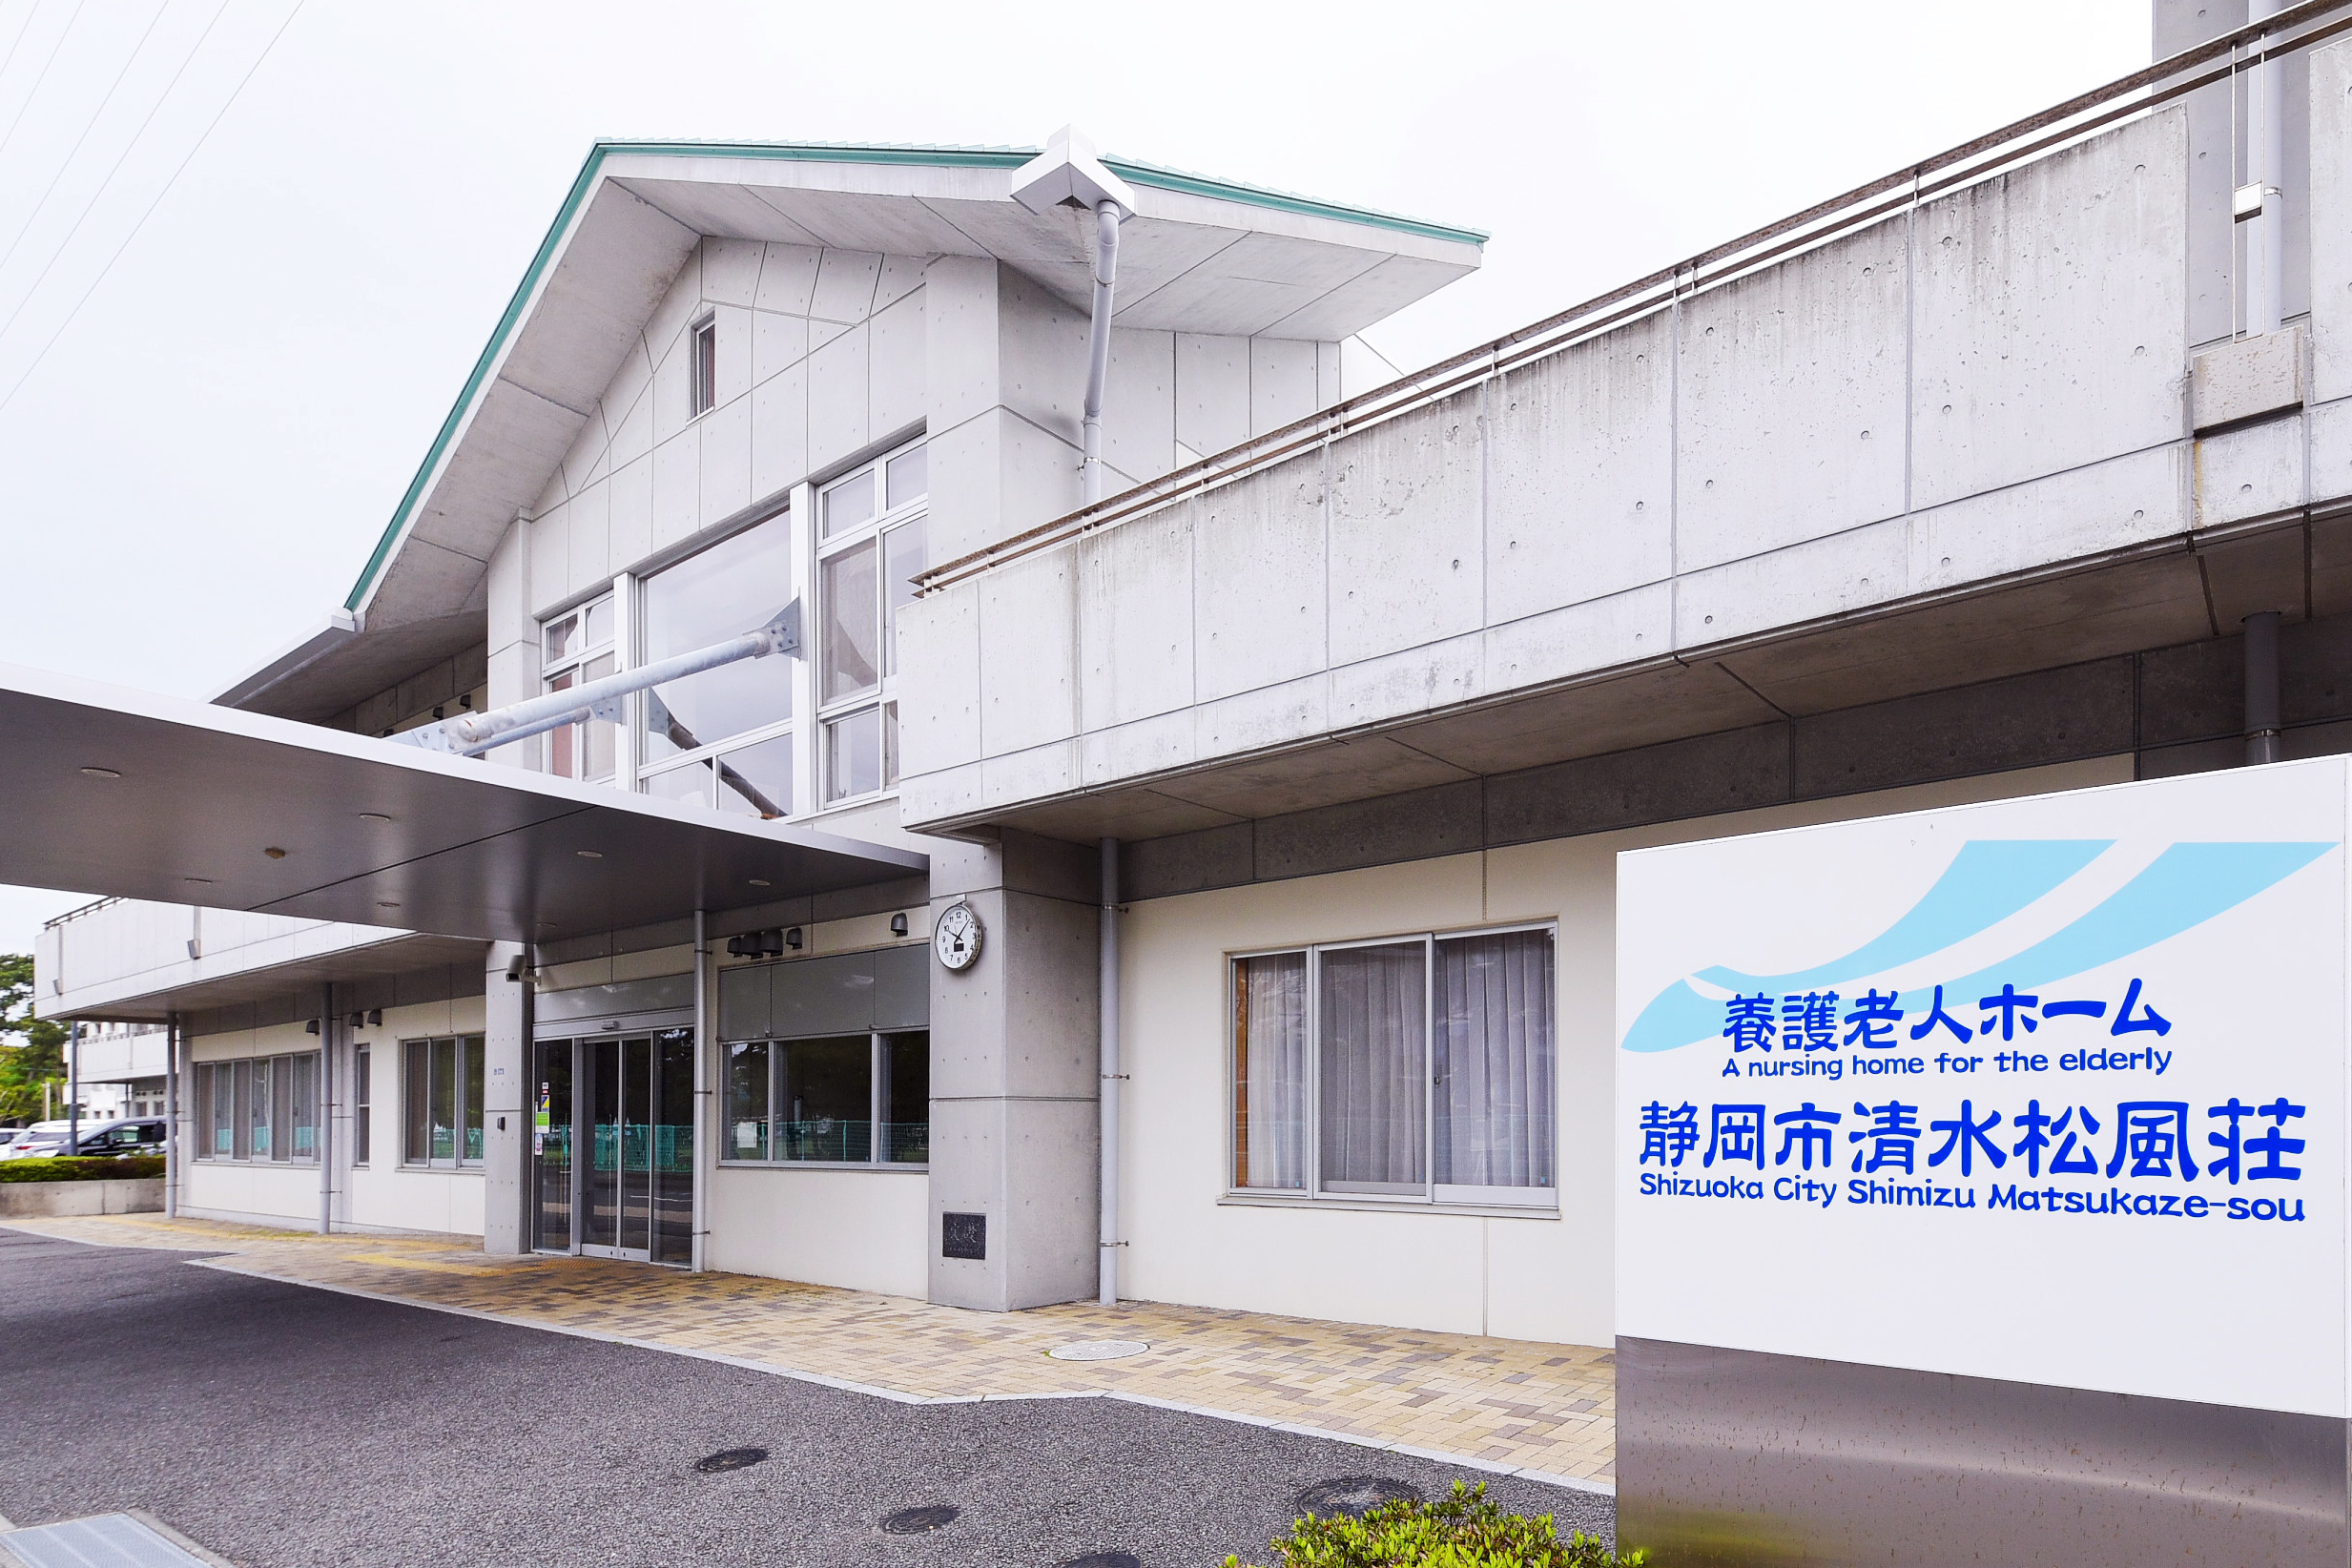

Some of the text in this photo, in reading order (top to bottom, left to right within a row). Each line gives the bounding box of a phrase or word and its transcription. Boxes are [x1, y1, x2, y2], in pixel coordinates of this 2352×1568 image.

[1722, 978, 2173, 1053] 養護老人ホーム
[1723, 1048, 2173, 1081] A nursing home for the elderly
[1639, 1097, 2306, 1186] 静岡市清水松風荘
[1640, 1172, 2306, 1222] Shizuoka City Shimizu Matsukaze-sou
